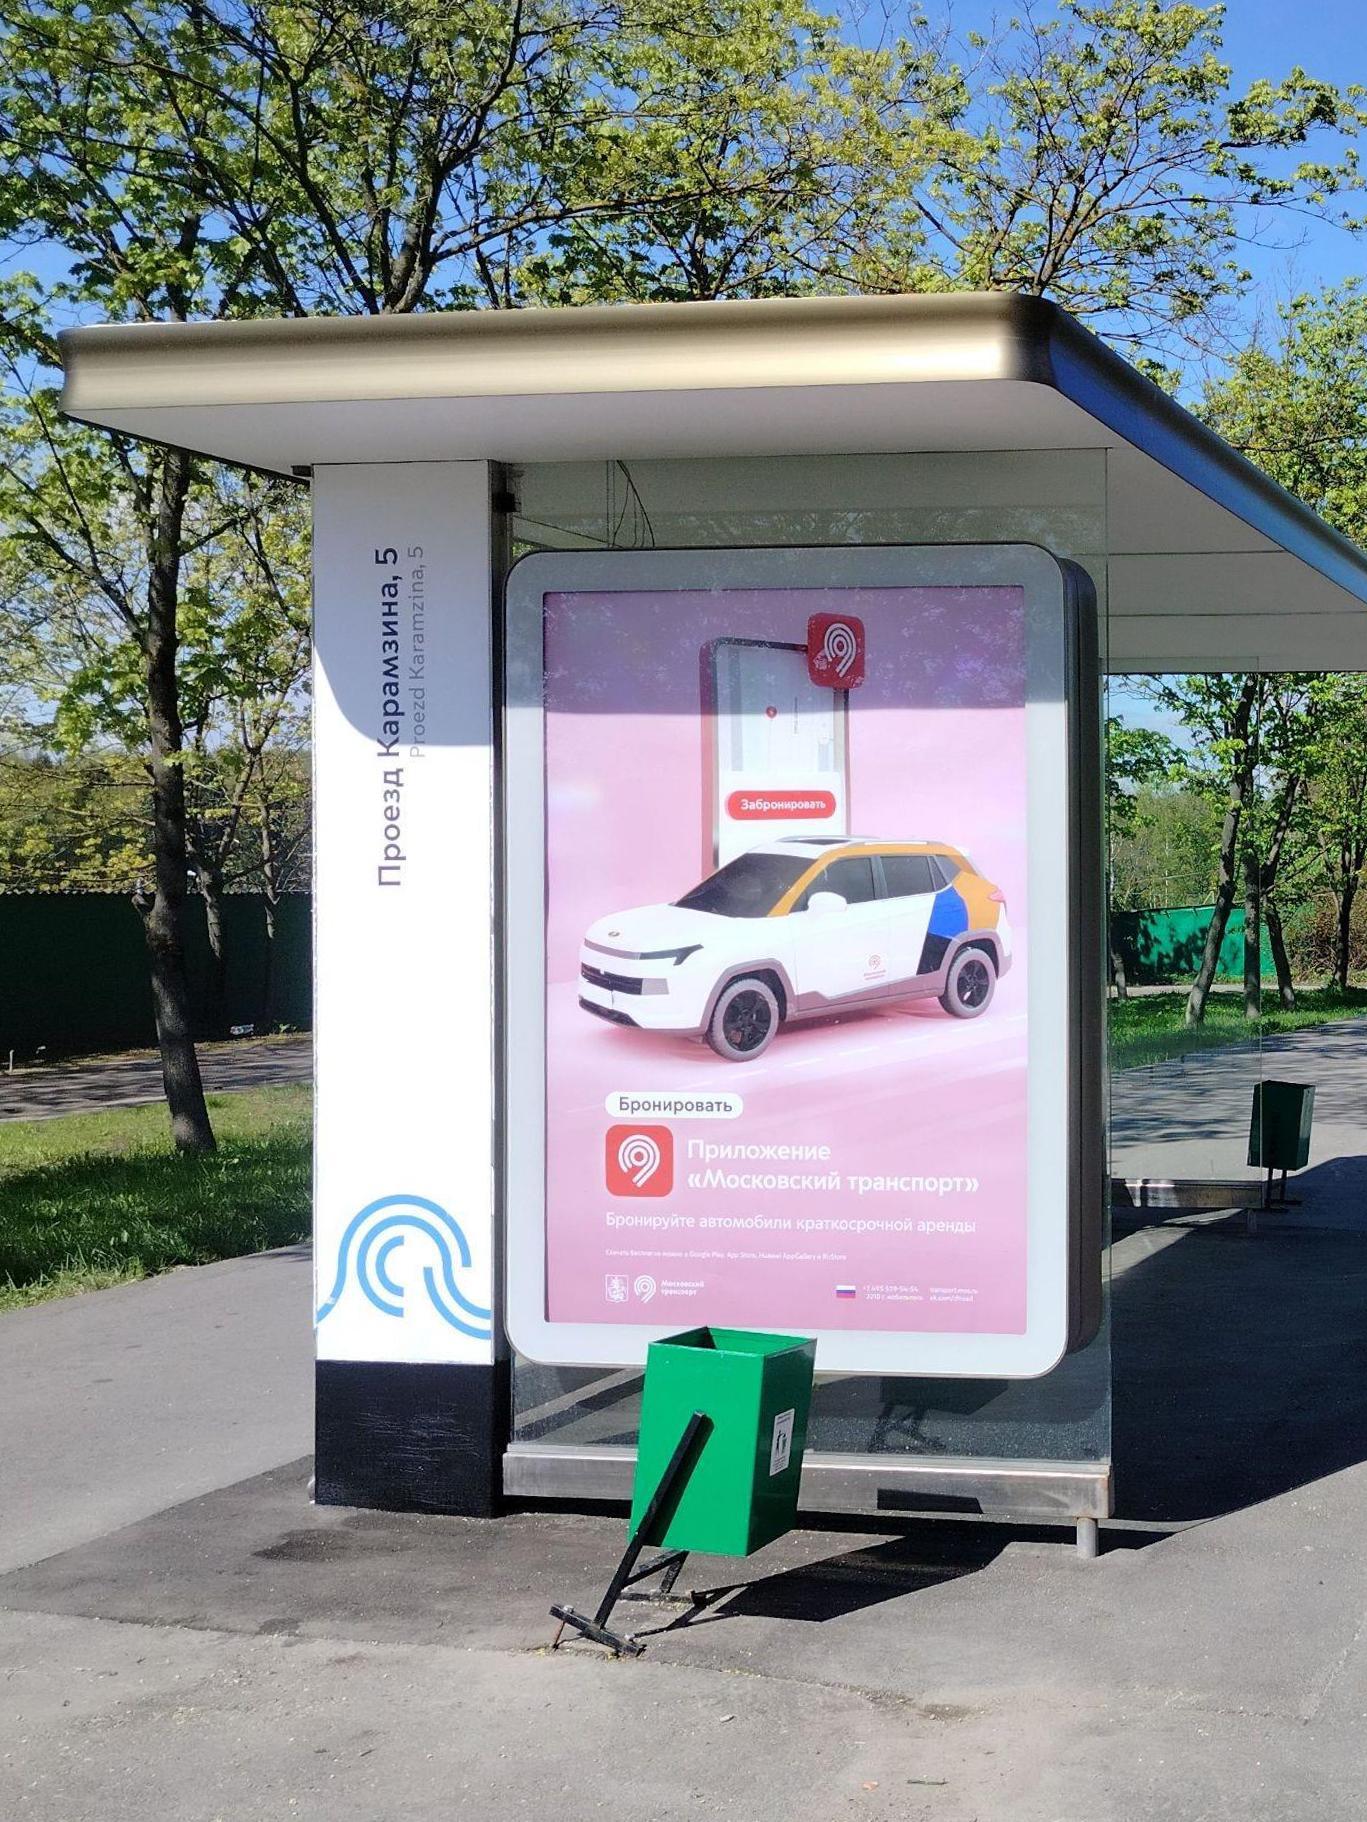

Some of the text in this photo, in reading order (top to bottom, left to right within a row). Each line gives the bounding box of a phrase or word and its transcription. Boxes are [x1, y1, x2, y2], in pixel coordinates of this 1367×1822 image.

[407, 546, 426, 758] Proezd Karamzina, 5
[374, 547, 406, 886] Проезд Карамзина, 5
[740, 798, 826, 812] Забронировать
[619, 1096, 733, 1115] Бронировать
[687, 1139, 832, 1163] Приложение
[687, 1169, 980, 1197] «Московский транспорт»
[605, 1211, 977, 1235] Бронируйте автомобили краткосрочной аренды
